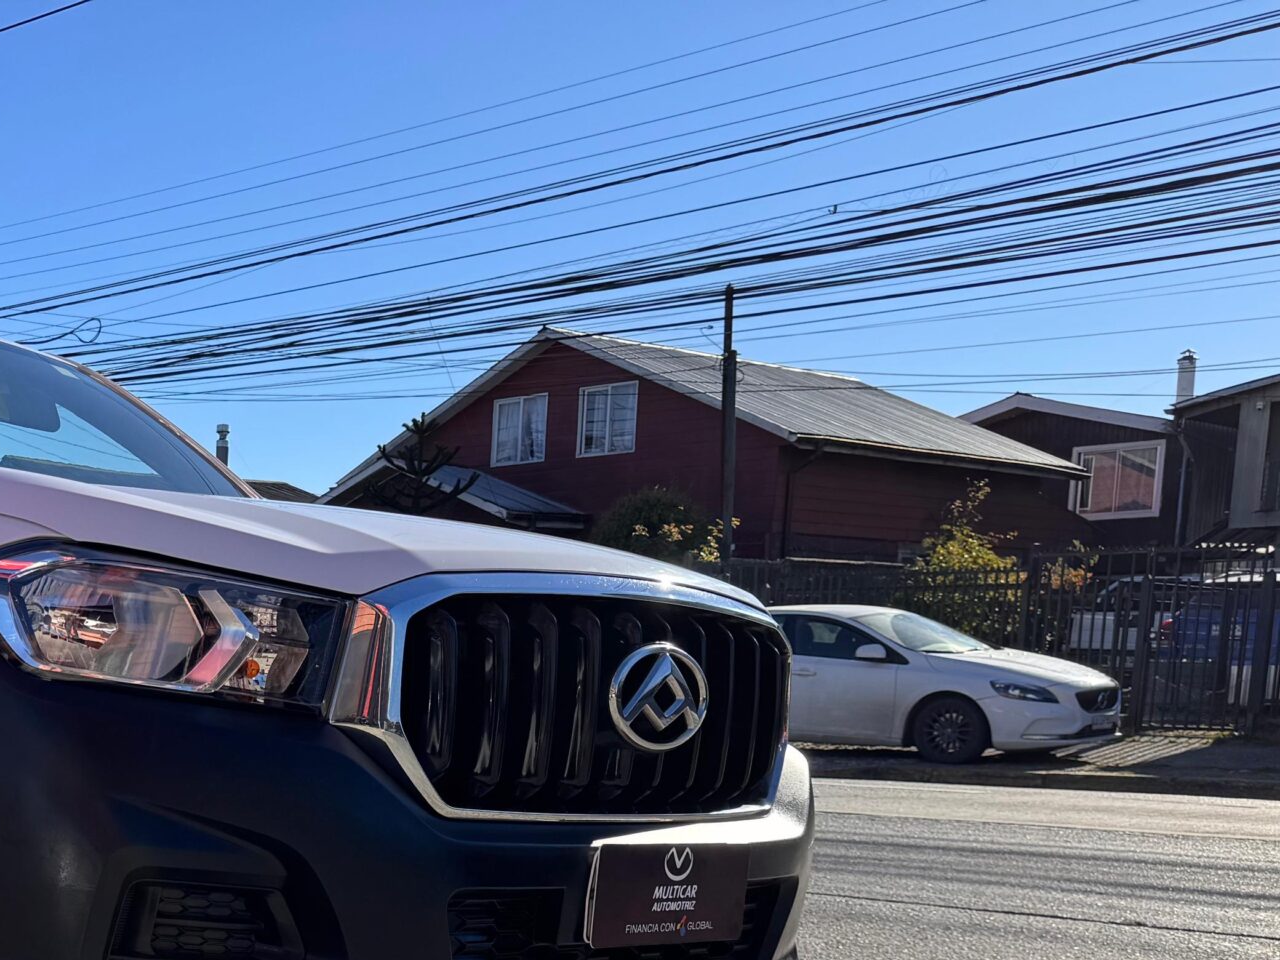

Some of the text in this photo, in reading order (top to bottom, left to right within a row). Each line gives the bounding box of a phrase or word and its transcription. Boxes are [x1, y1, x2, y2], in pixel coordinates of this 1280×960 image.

[652, 884, 698, 900] MULTICAR
[651, 901, 696, 912] AUTOMOTRIZ
[625, 920, 713, 934] FINANCIA CON GLOBAL
